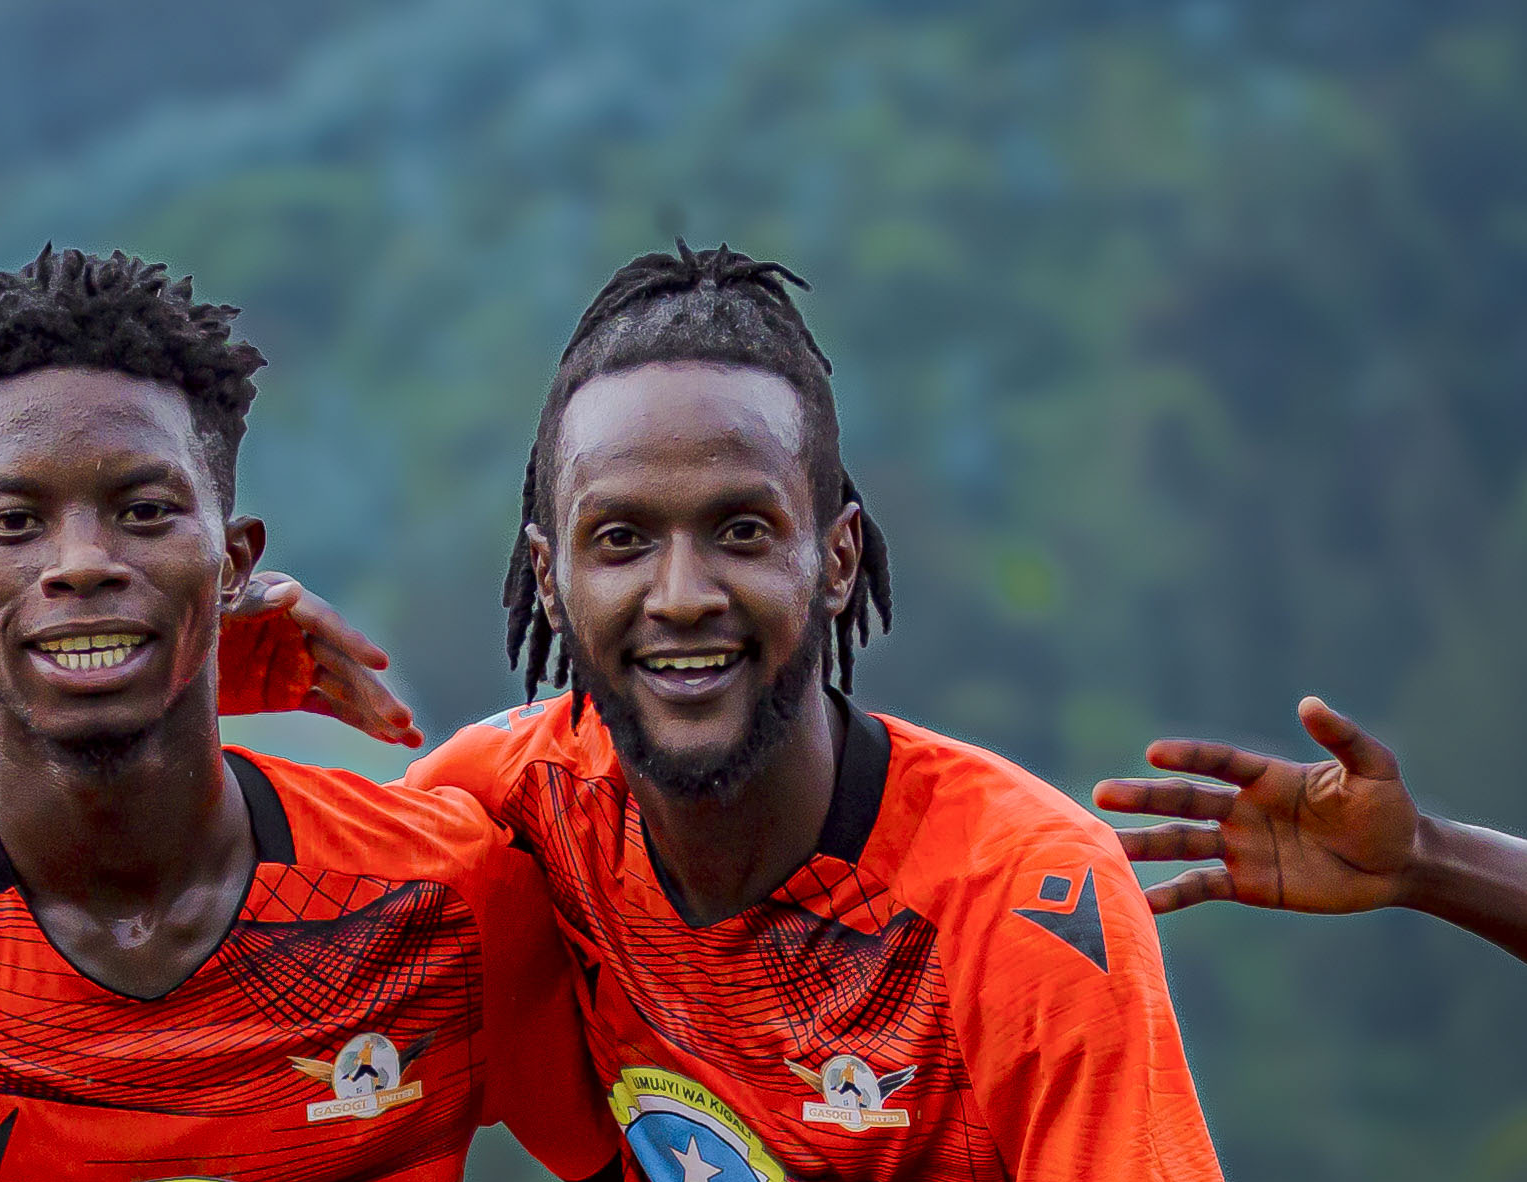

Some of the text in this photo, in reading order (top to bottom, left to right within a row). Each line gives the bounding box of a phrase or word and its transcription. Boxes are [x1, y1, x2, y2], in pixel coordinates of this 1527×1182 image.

[633, 1076, 752, 1140] UMUJYI WA KIGALI
[808, 1107, 853, 1121] GASOGI
